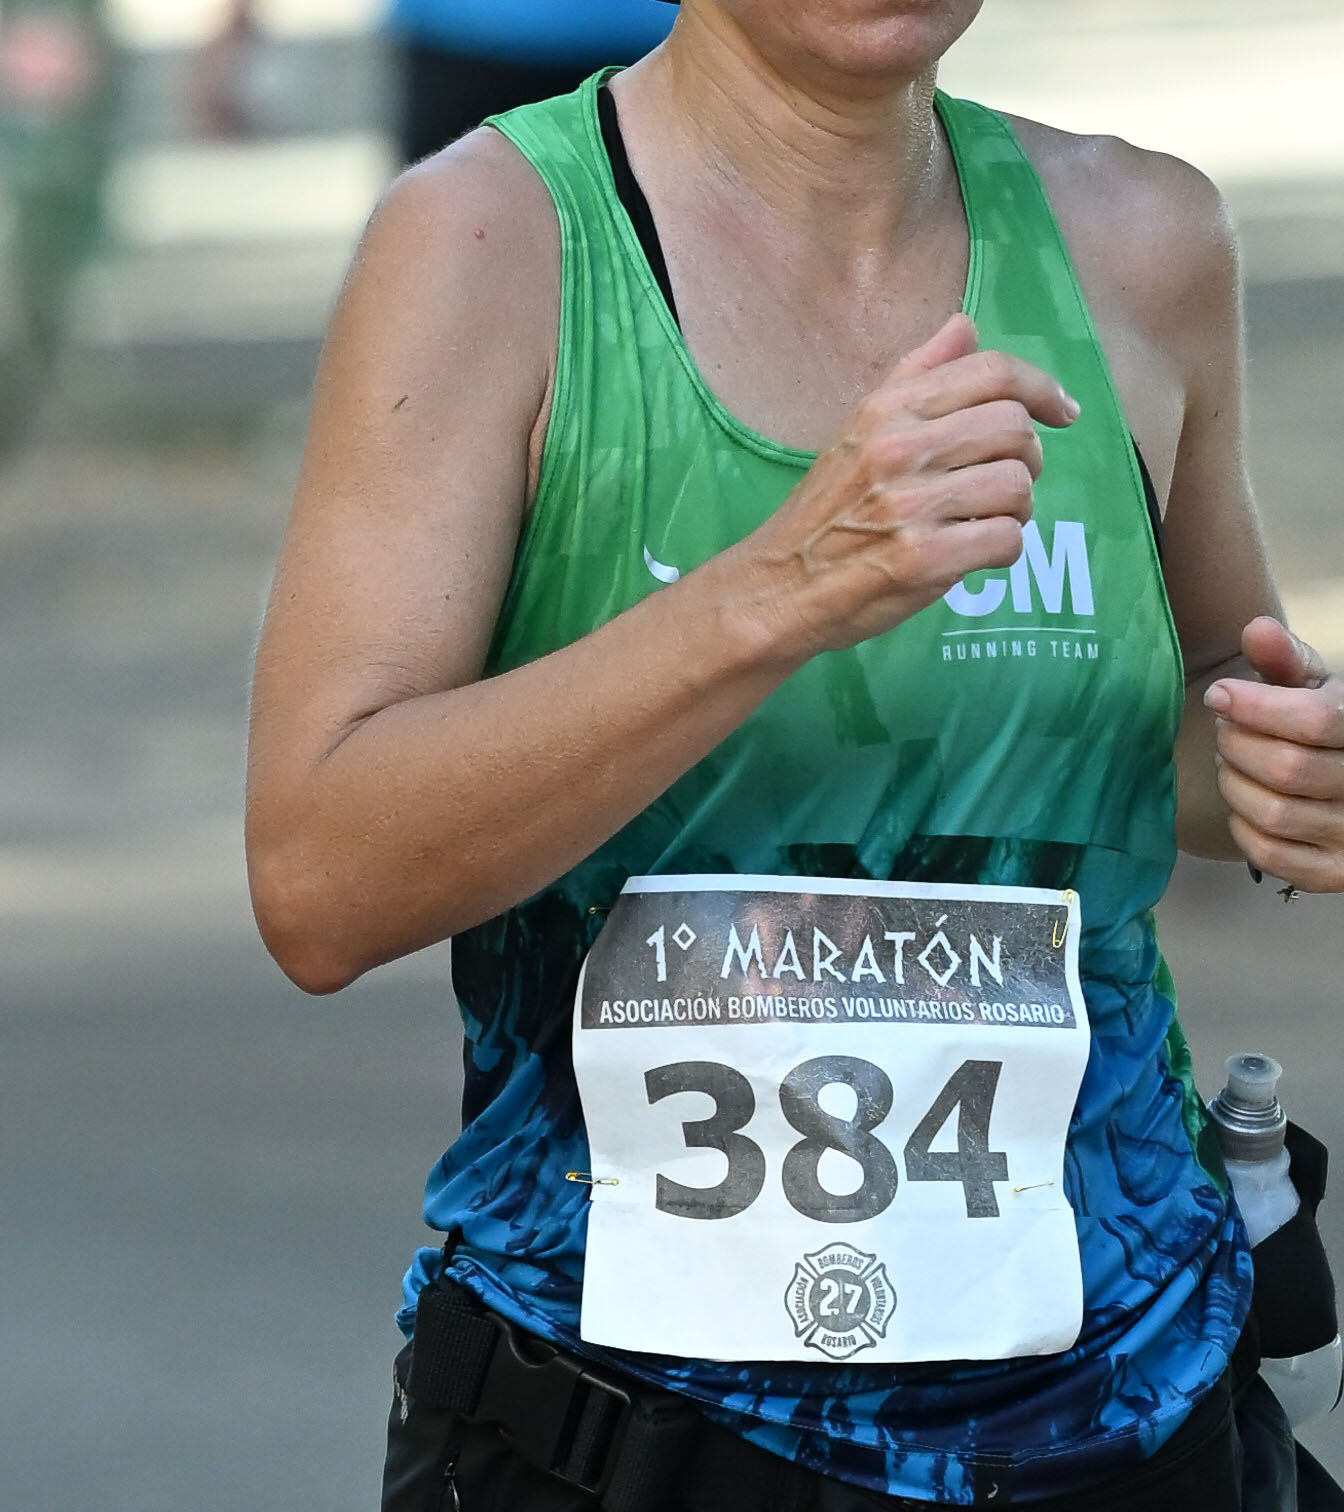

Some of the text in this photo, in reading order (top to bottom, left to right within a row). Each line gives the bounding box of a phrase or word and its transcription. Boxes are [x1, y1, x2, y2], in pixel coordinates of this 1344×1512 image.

[942, 640, 1099, 661] RUNNING TEAM
[720, 914, 1004, 987] MARATÓN
[599, 991, 1065, 1024] ASOCIACIÓN BOMBEROS VOLUNTARIOS ROSARIO
[644, 1055, 1009, 1223] 384
[817, 1253, 864, 1270] BOMBEROS
[819, 1277, 863, 1317] 27
[820, 1333, 857, 1348] ROSARIO
